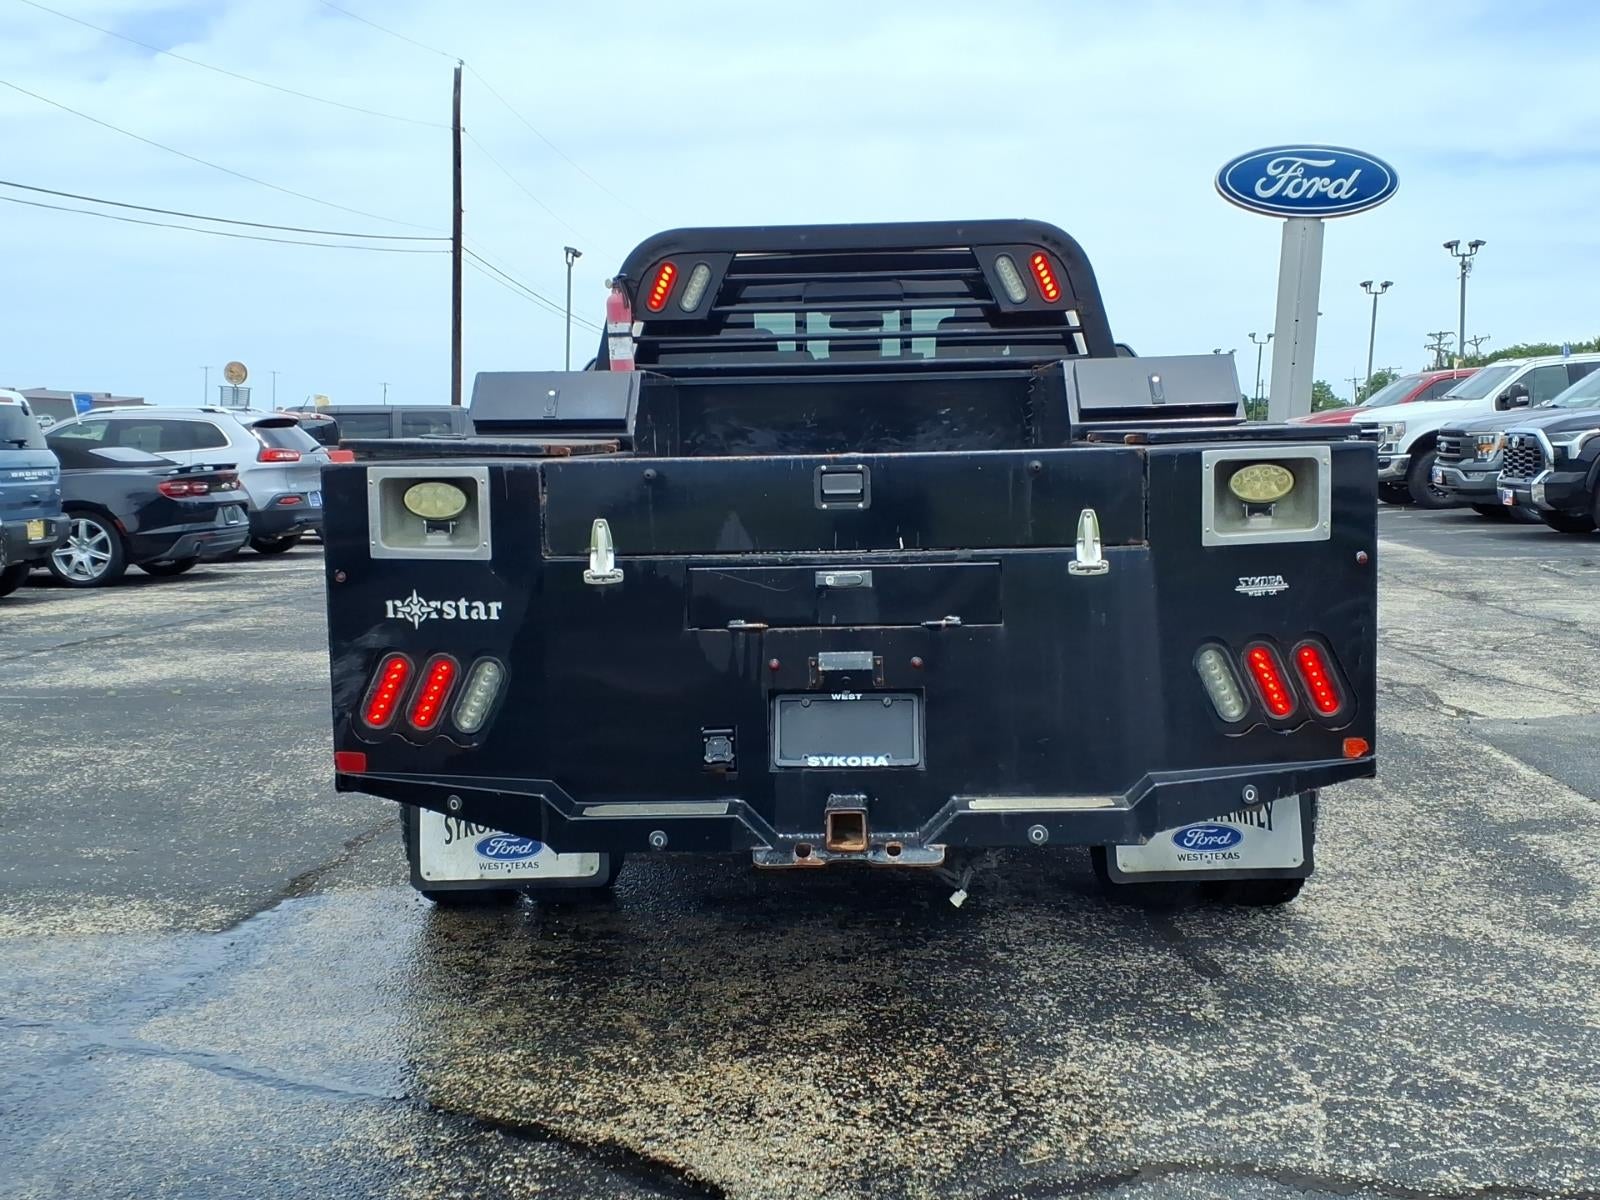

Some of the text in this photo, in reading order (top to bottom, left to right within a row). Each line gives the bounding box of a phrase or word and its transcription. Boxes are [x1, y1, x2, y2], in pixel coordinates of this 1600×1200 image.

[1254, 156, 1361, 200] Ford
[385, 590, 502, 629] norstar
[807, 755, 889, 766] SYKORA
[485, 836, 533, 855] Ford
[1183, 828, 1233, 847] Ford
[479, 862, 540, 871] WEST TEXAS
[1177, 852, 1240, 862] WEST TEXAS
